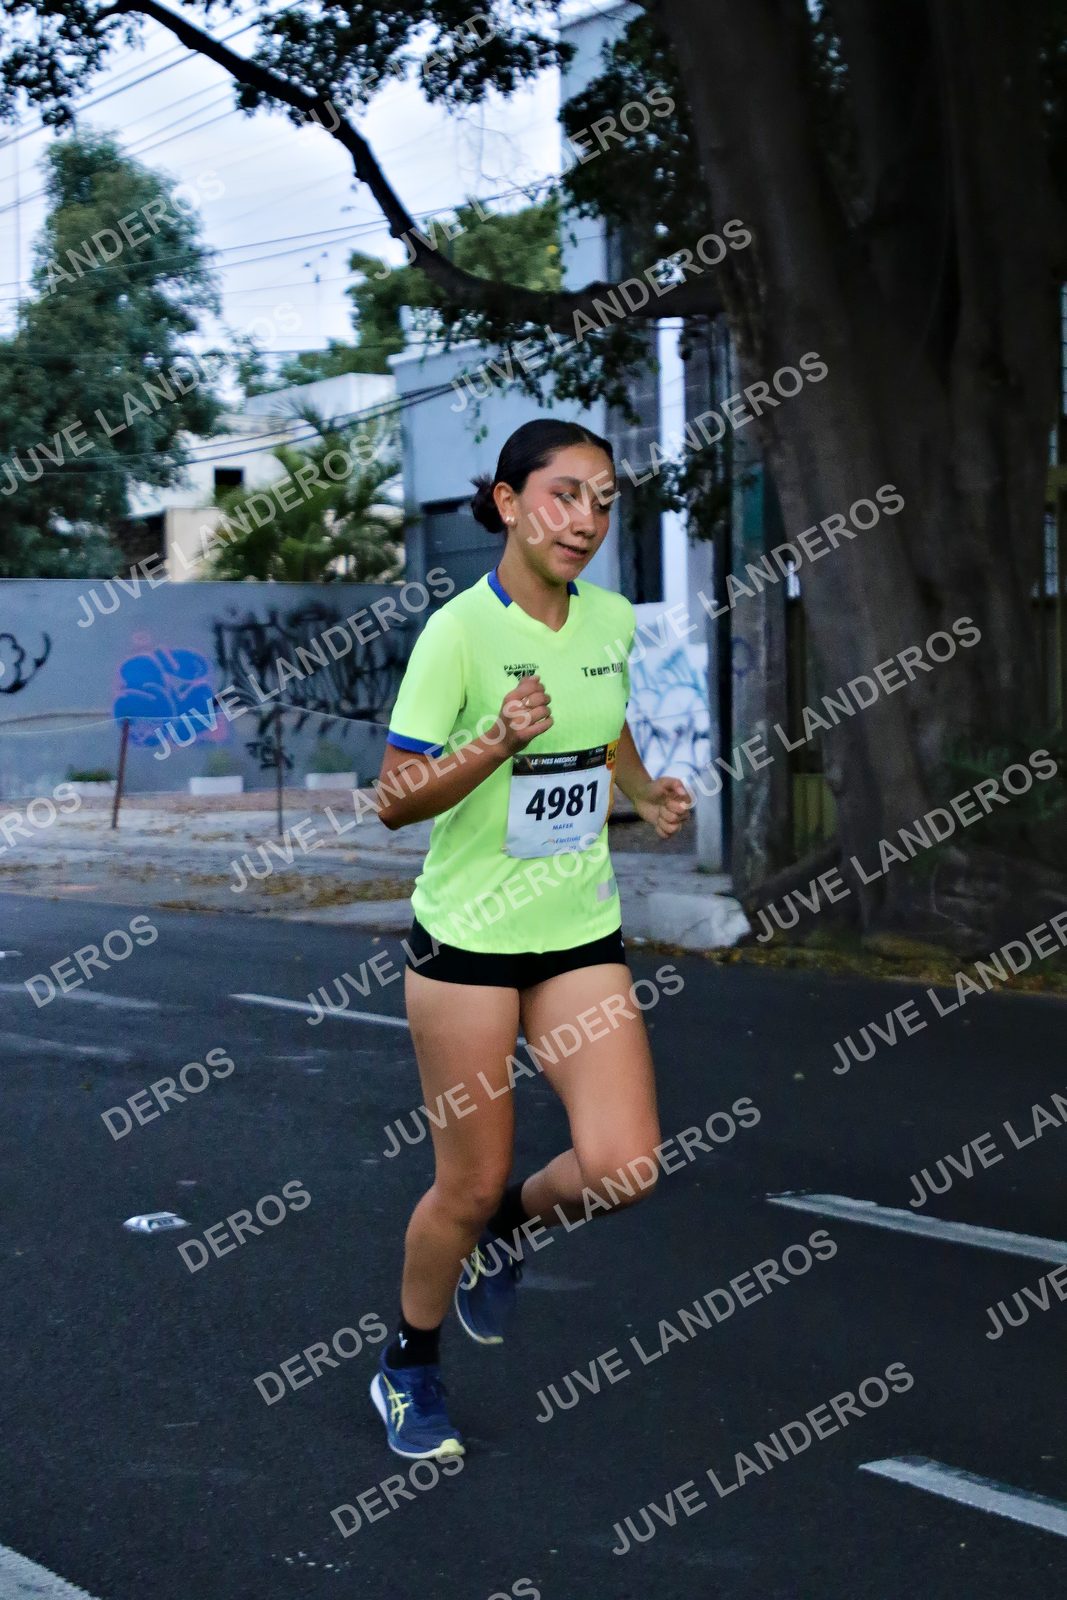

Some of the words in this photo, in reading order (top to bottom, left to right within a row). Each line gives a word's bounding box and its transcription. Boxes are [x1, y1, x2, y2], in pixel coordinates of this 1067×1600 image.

[581, 665, 610, 677] Team
[531, 757, 554, 765] LENES
[526, 780, 598, 821] 4981
[552, 822, 574, 830] MAFER
